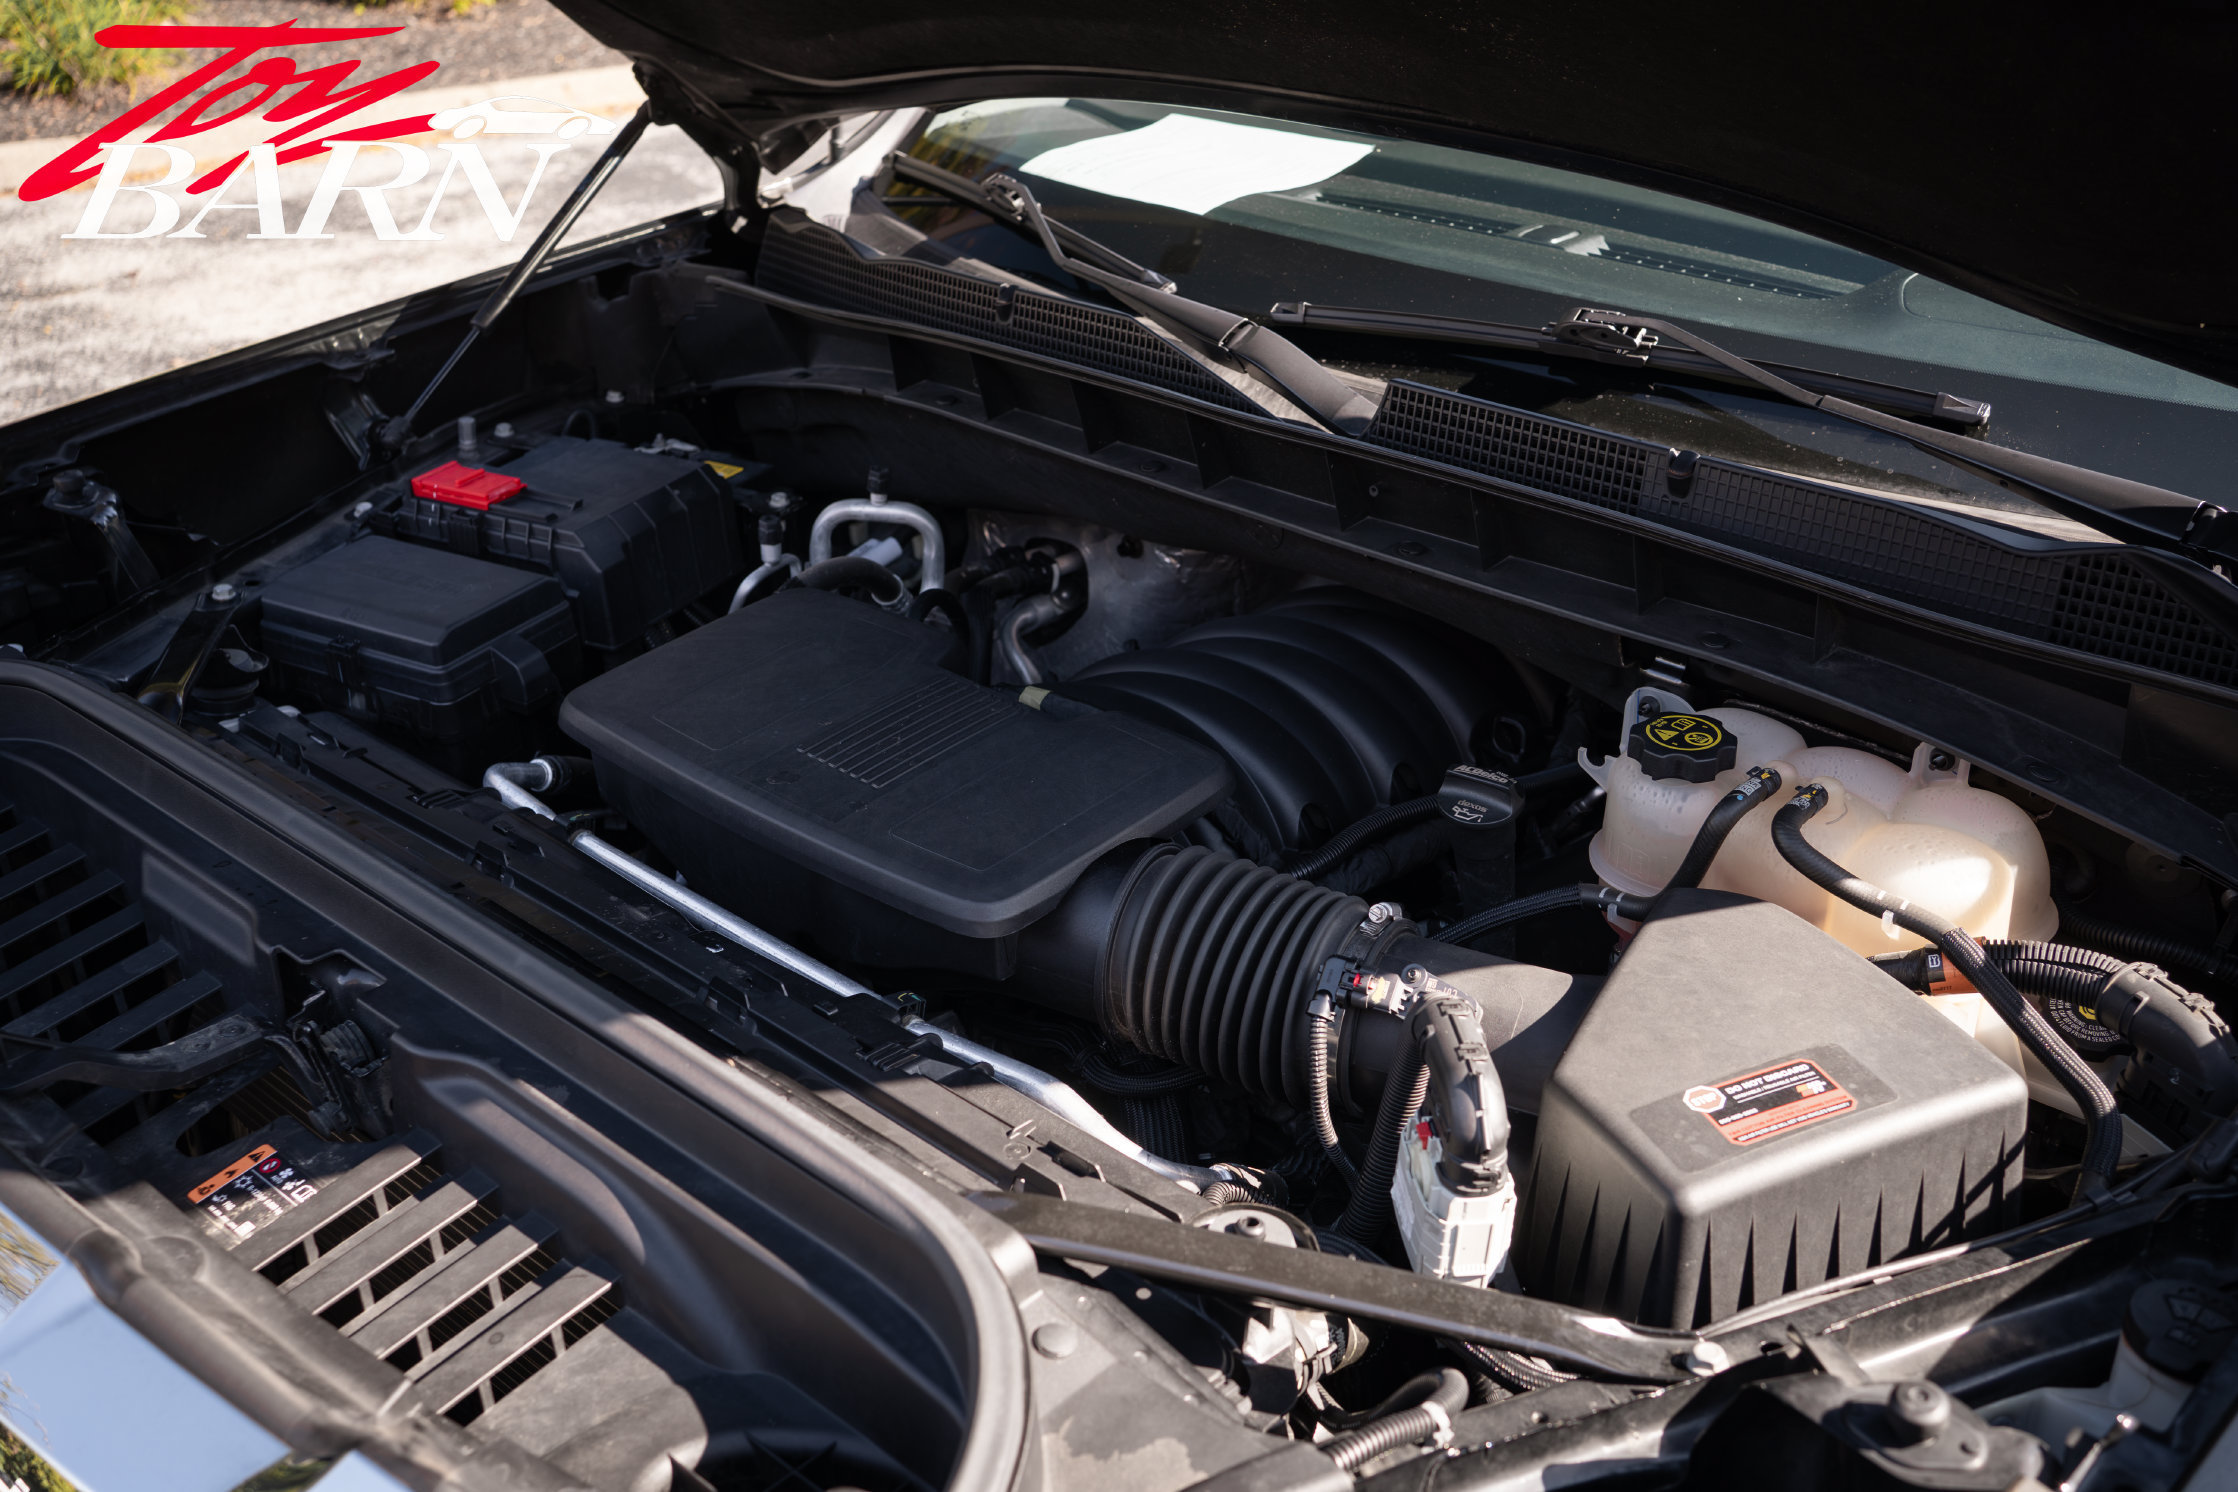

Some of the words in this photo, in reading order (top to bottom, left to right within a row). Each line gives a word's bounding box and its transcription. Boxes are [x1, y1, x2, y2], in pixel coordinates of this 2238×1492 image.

[1454, 765, 1509, 783] ACDelco
[1457, 799, 1488, 813] dexos
[1724, 1084, 1743, 1095] DO
[1741, 1077, 1764, 1089] NOT
[1762, 1063, 1810, 1082] DISCARD
[1691, 1092, 1717, 1106] STOP
